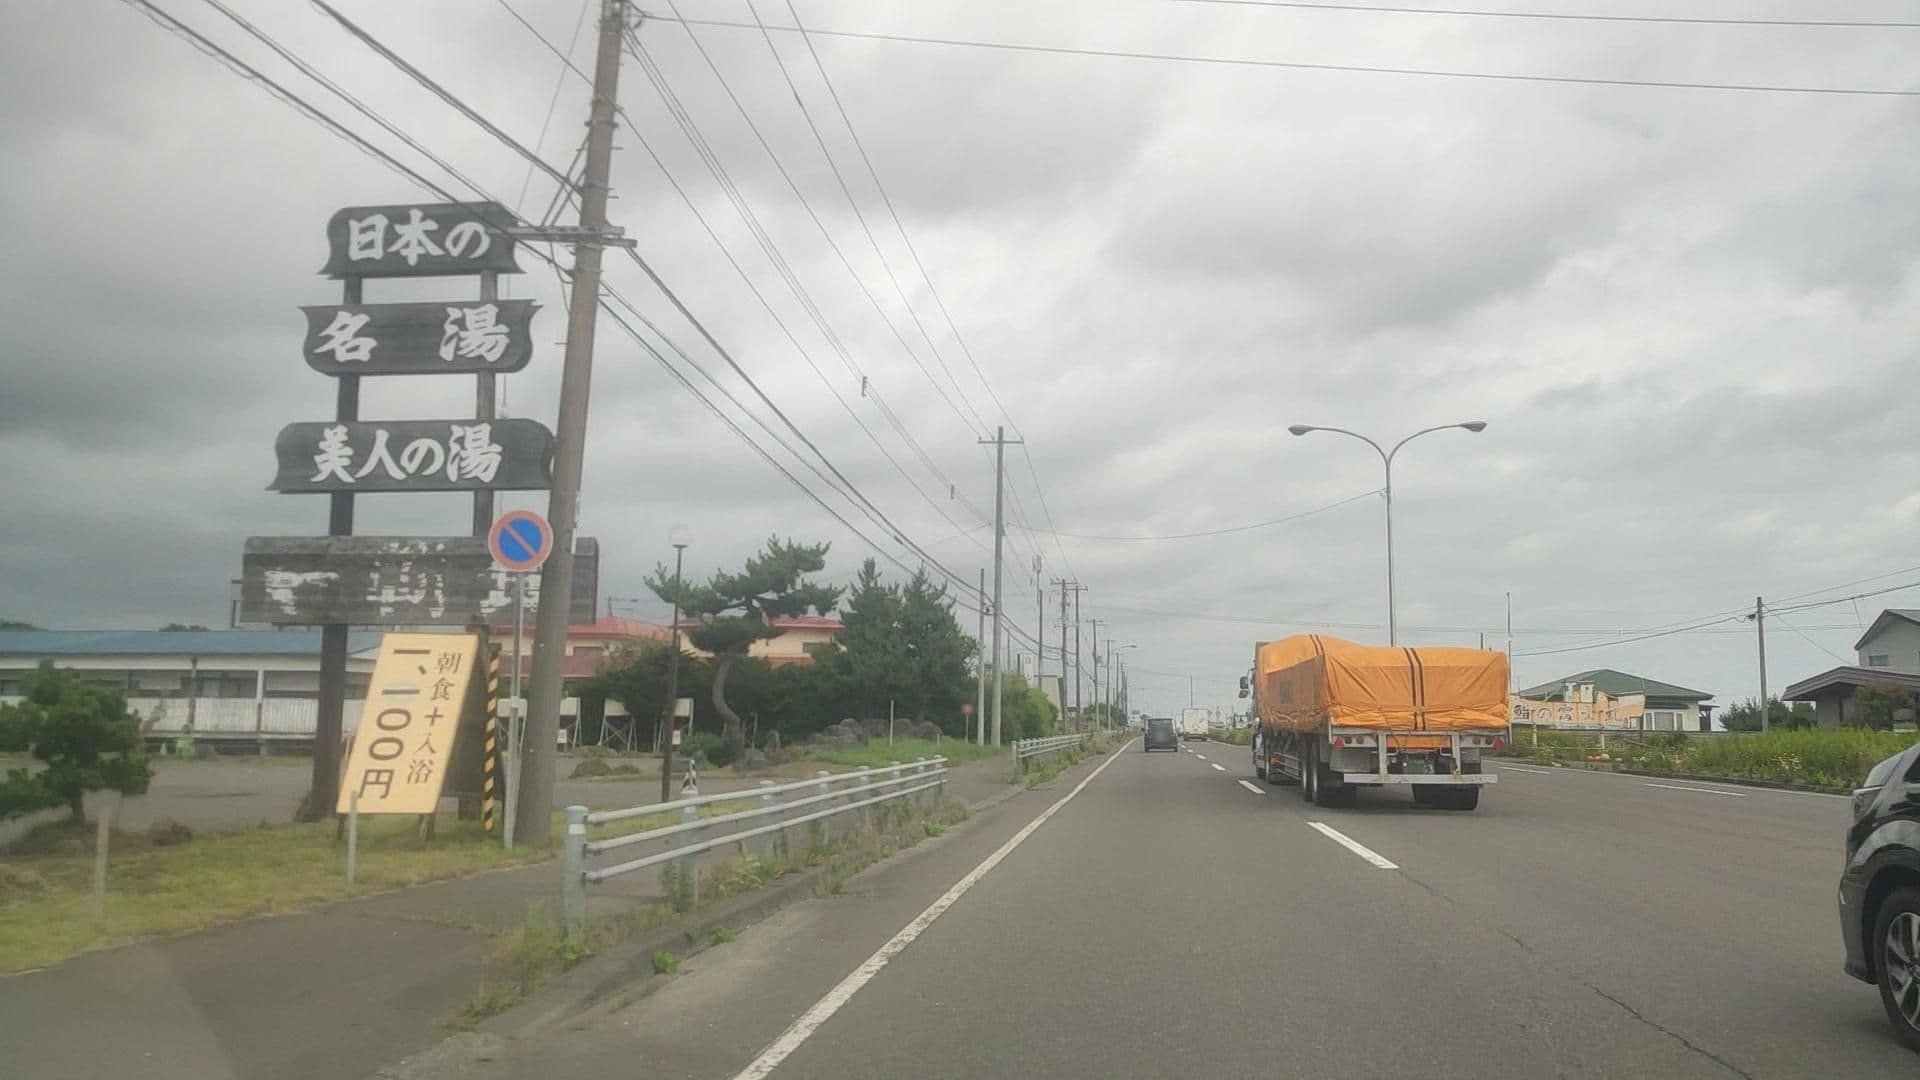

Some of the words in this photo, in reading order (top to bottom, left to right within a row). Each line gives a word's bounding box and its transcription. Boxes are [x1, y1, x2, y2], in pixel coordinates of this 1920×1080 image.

[348, 209, 490, 266] 日本の
[314, 304, 511, 363] 名湯
[310, 423, 503, 483] 美人の湯
